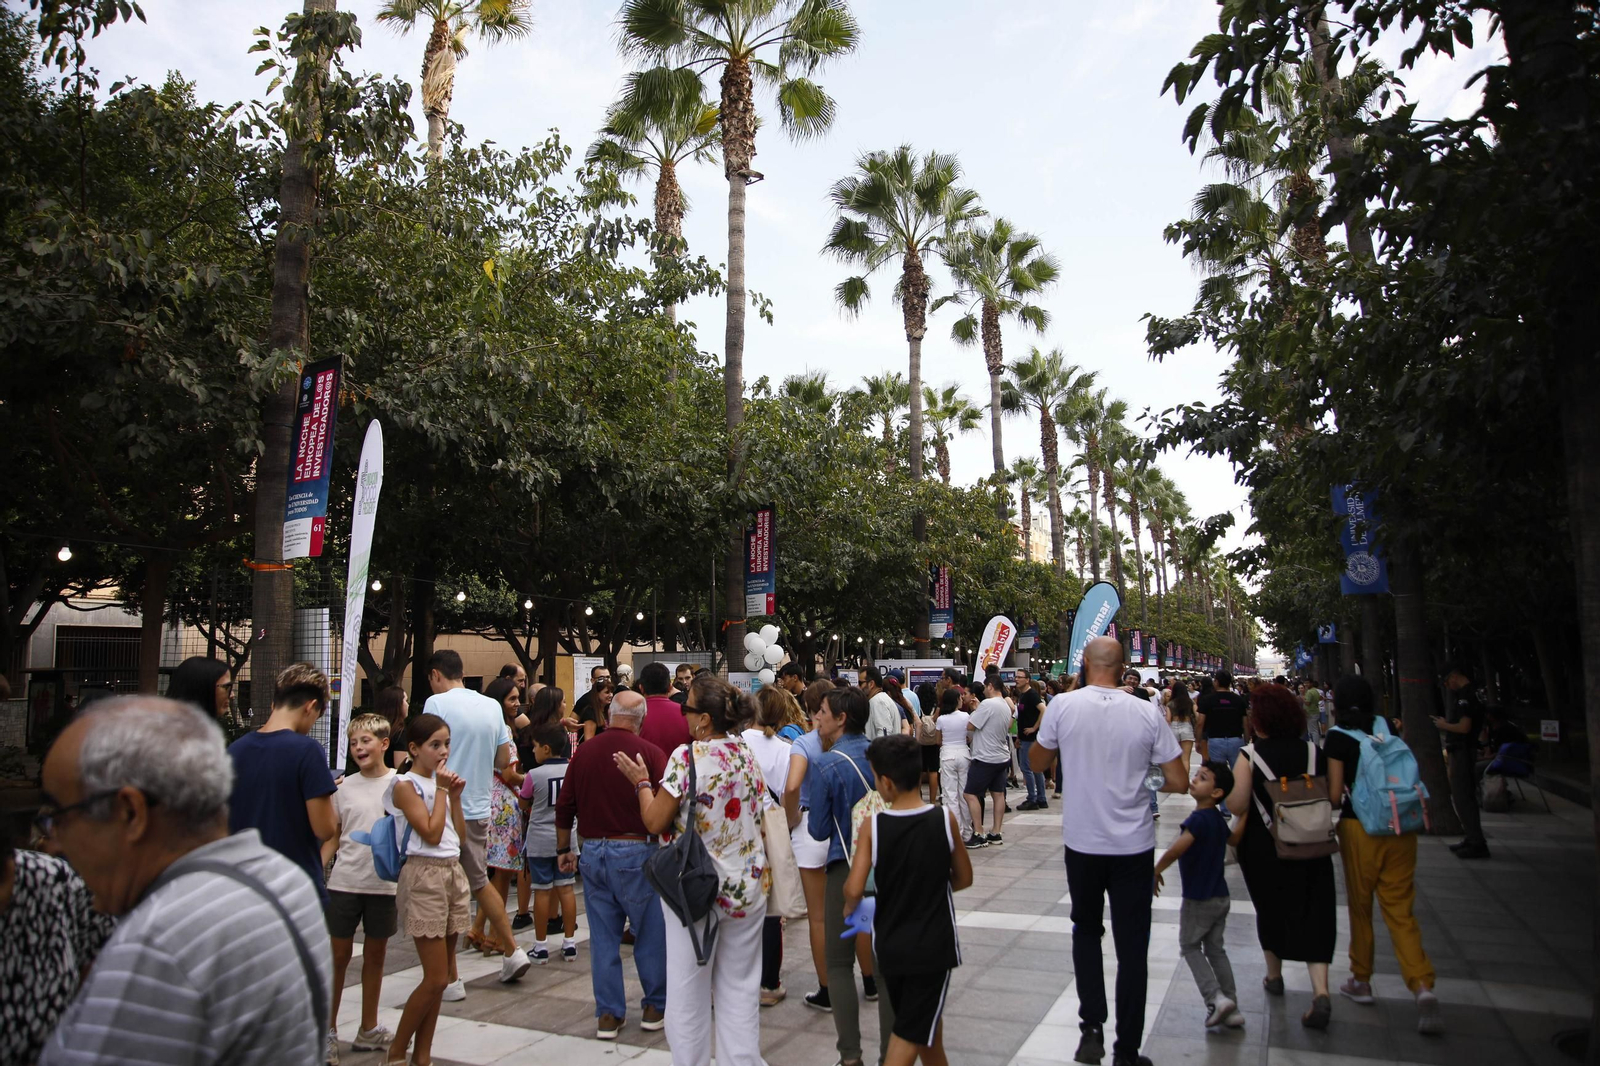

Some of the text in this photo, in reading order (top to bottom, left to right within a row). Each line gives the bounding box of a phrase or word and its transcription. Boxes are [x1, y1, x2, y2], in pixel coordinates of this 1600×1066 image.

[304, 375, 325, 478] EUROPEA DE L@S
[313, 373, 333, 477] INVESTIGADOR@S
[299, 416, 310, 458] NOCHE
[295, 463, 304, 480] LA
[291, 498, 319, 507] UNIVERSIDAD
[313, 524, 322, 532] 61
[757, 528, 763, 538] DE
[750, 562, 756, 573] LA
[1083, 600, 1111, 649] cajamar
